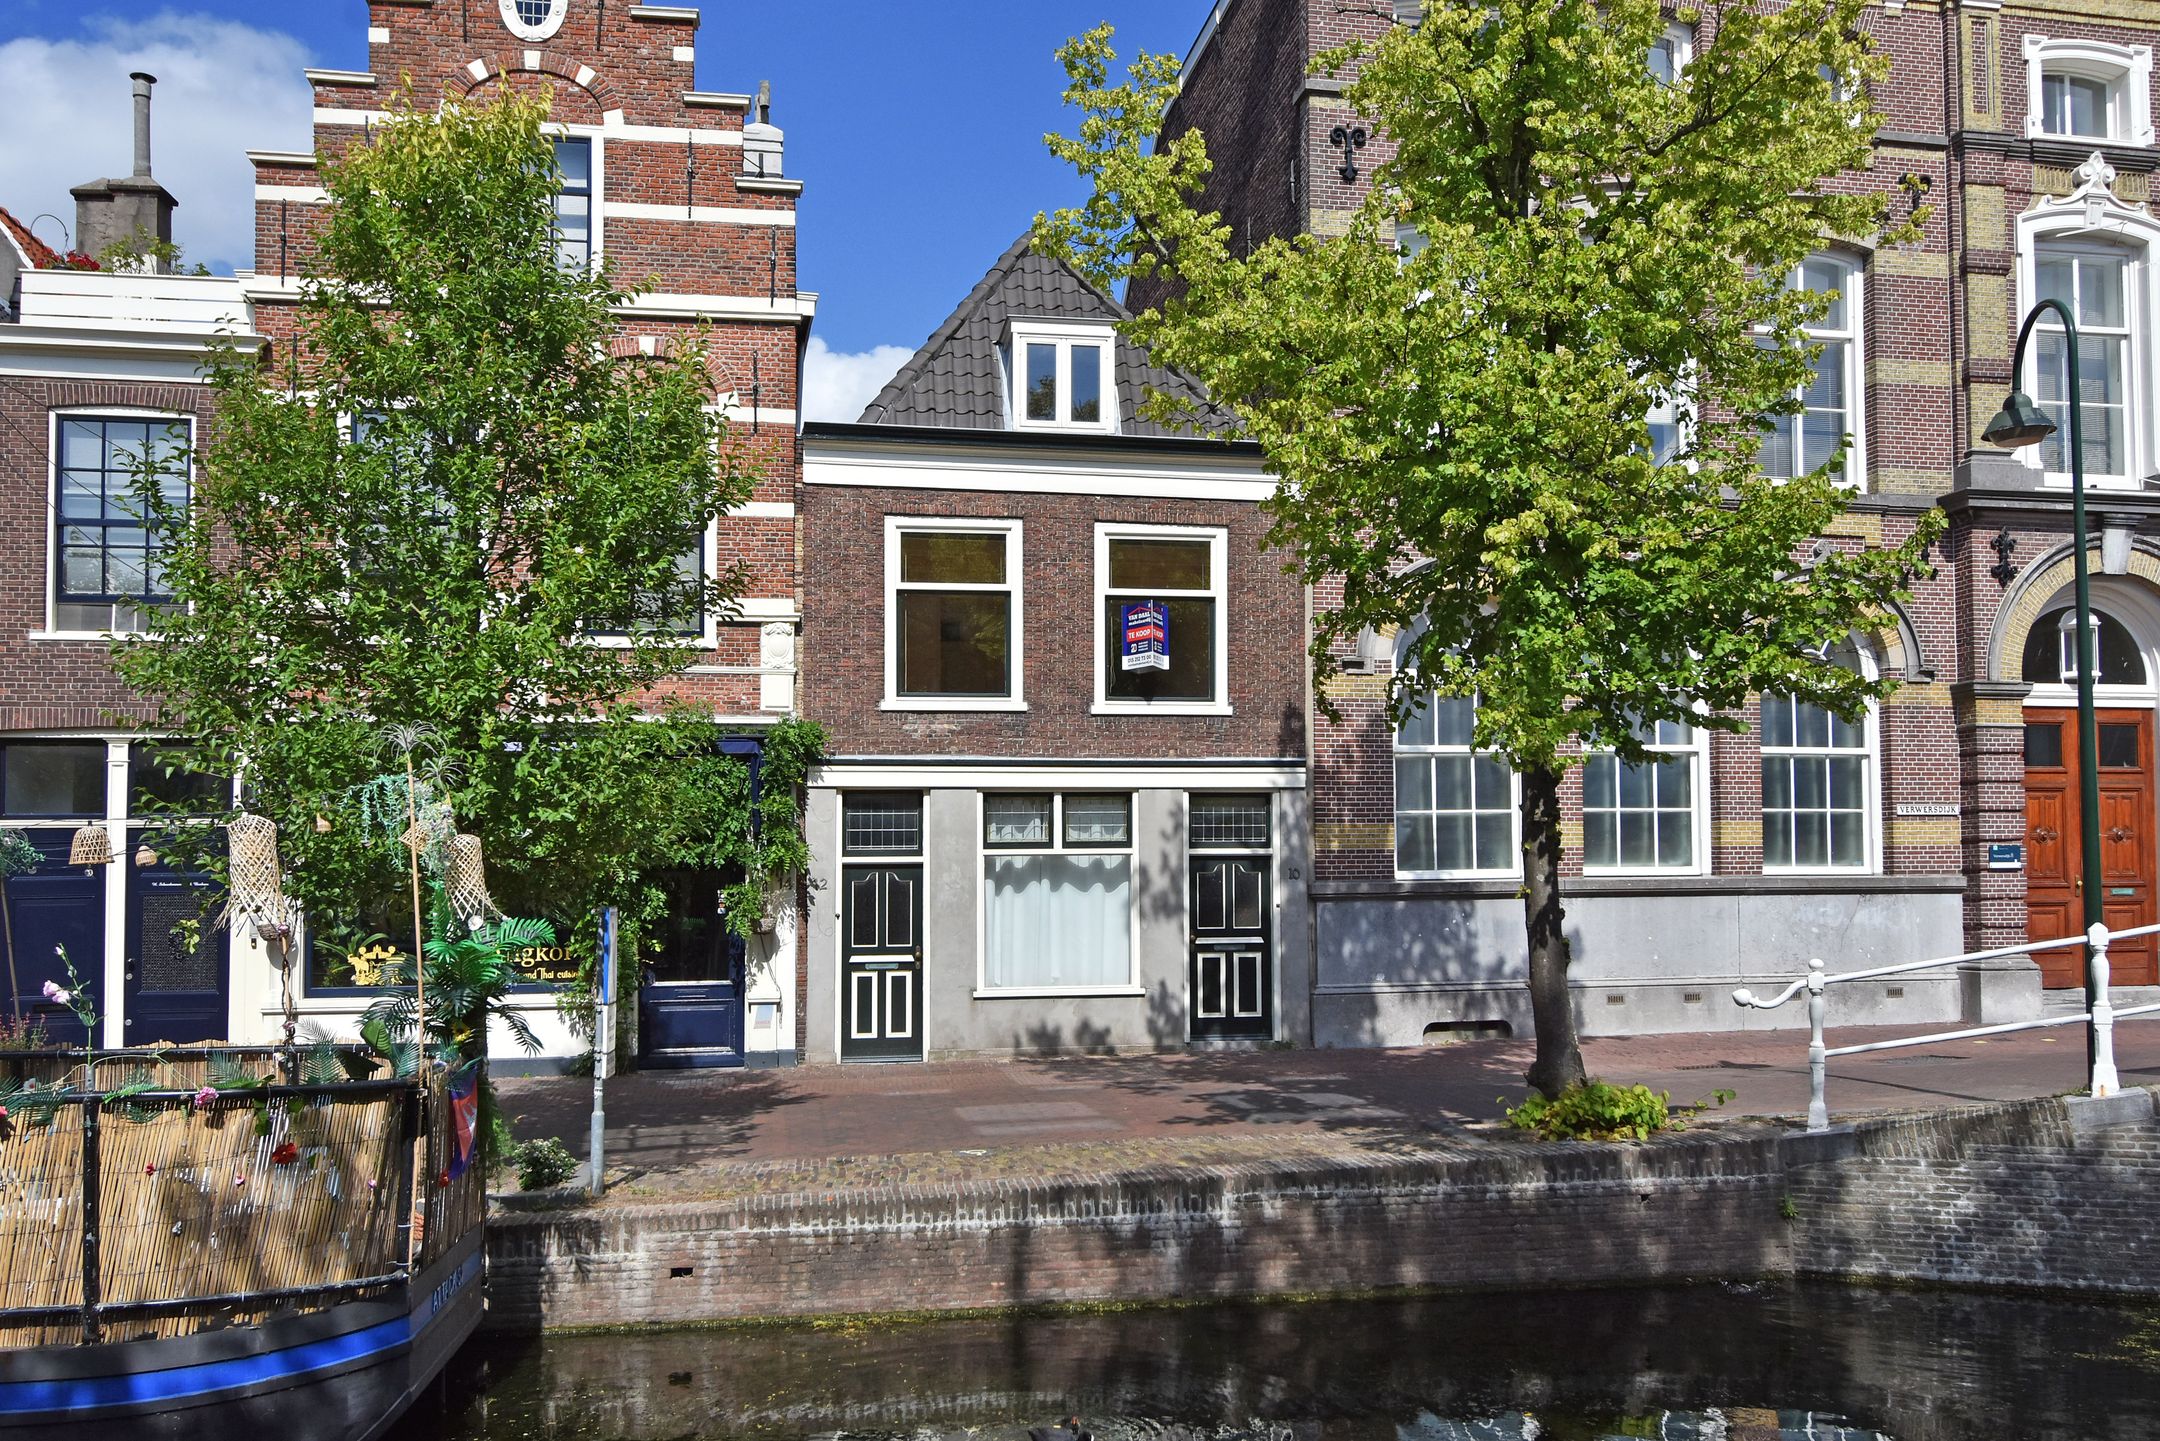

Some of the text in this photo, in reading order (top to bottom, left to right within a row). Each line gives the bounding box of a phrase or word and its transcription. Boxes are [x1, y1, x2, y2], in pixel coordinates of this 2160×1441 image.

[1135, 629, 1151, 638] KOOP
[1288, 867, 1300, 880] 10
[537, 967, 554, 980] Thai
